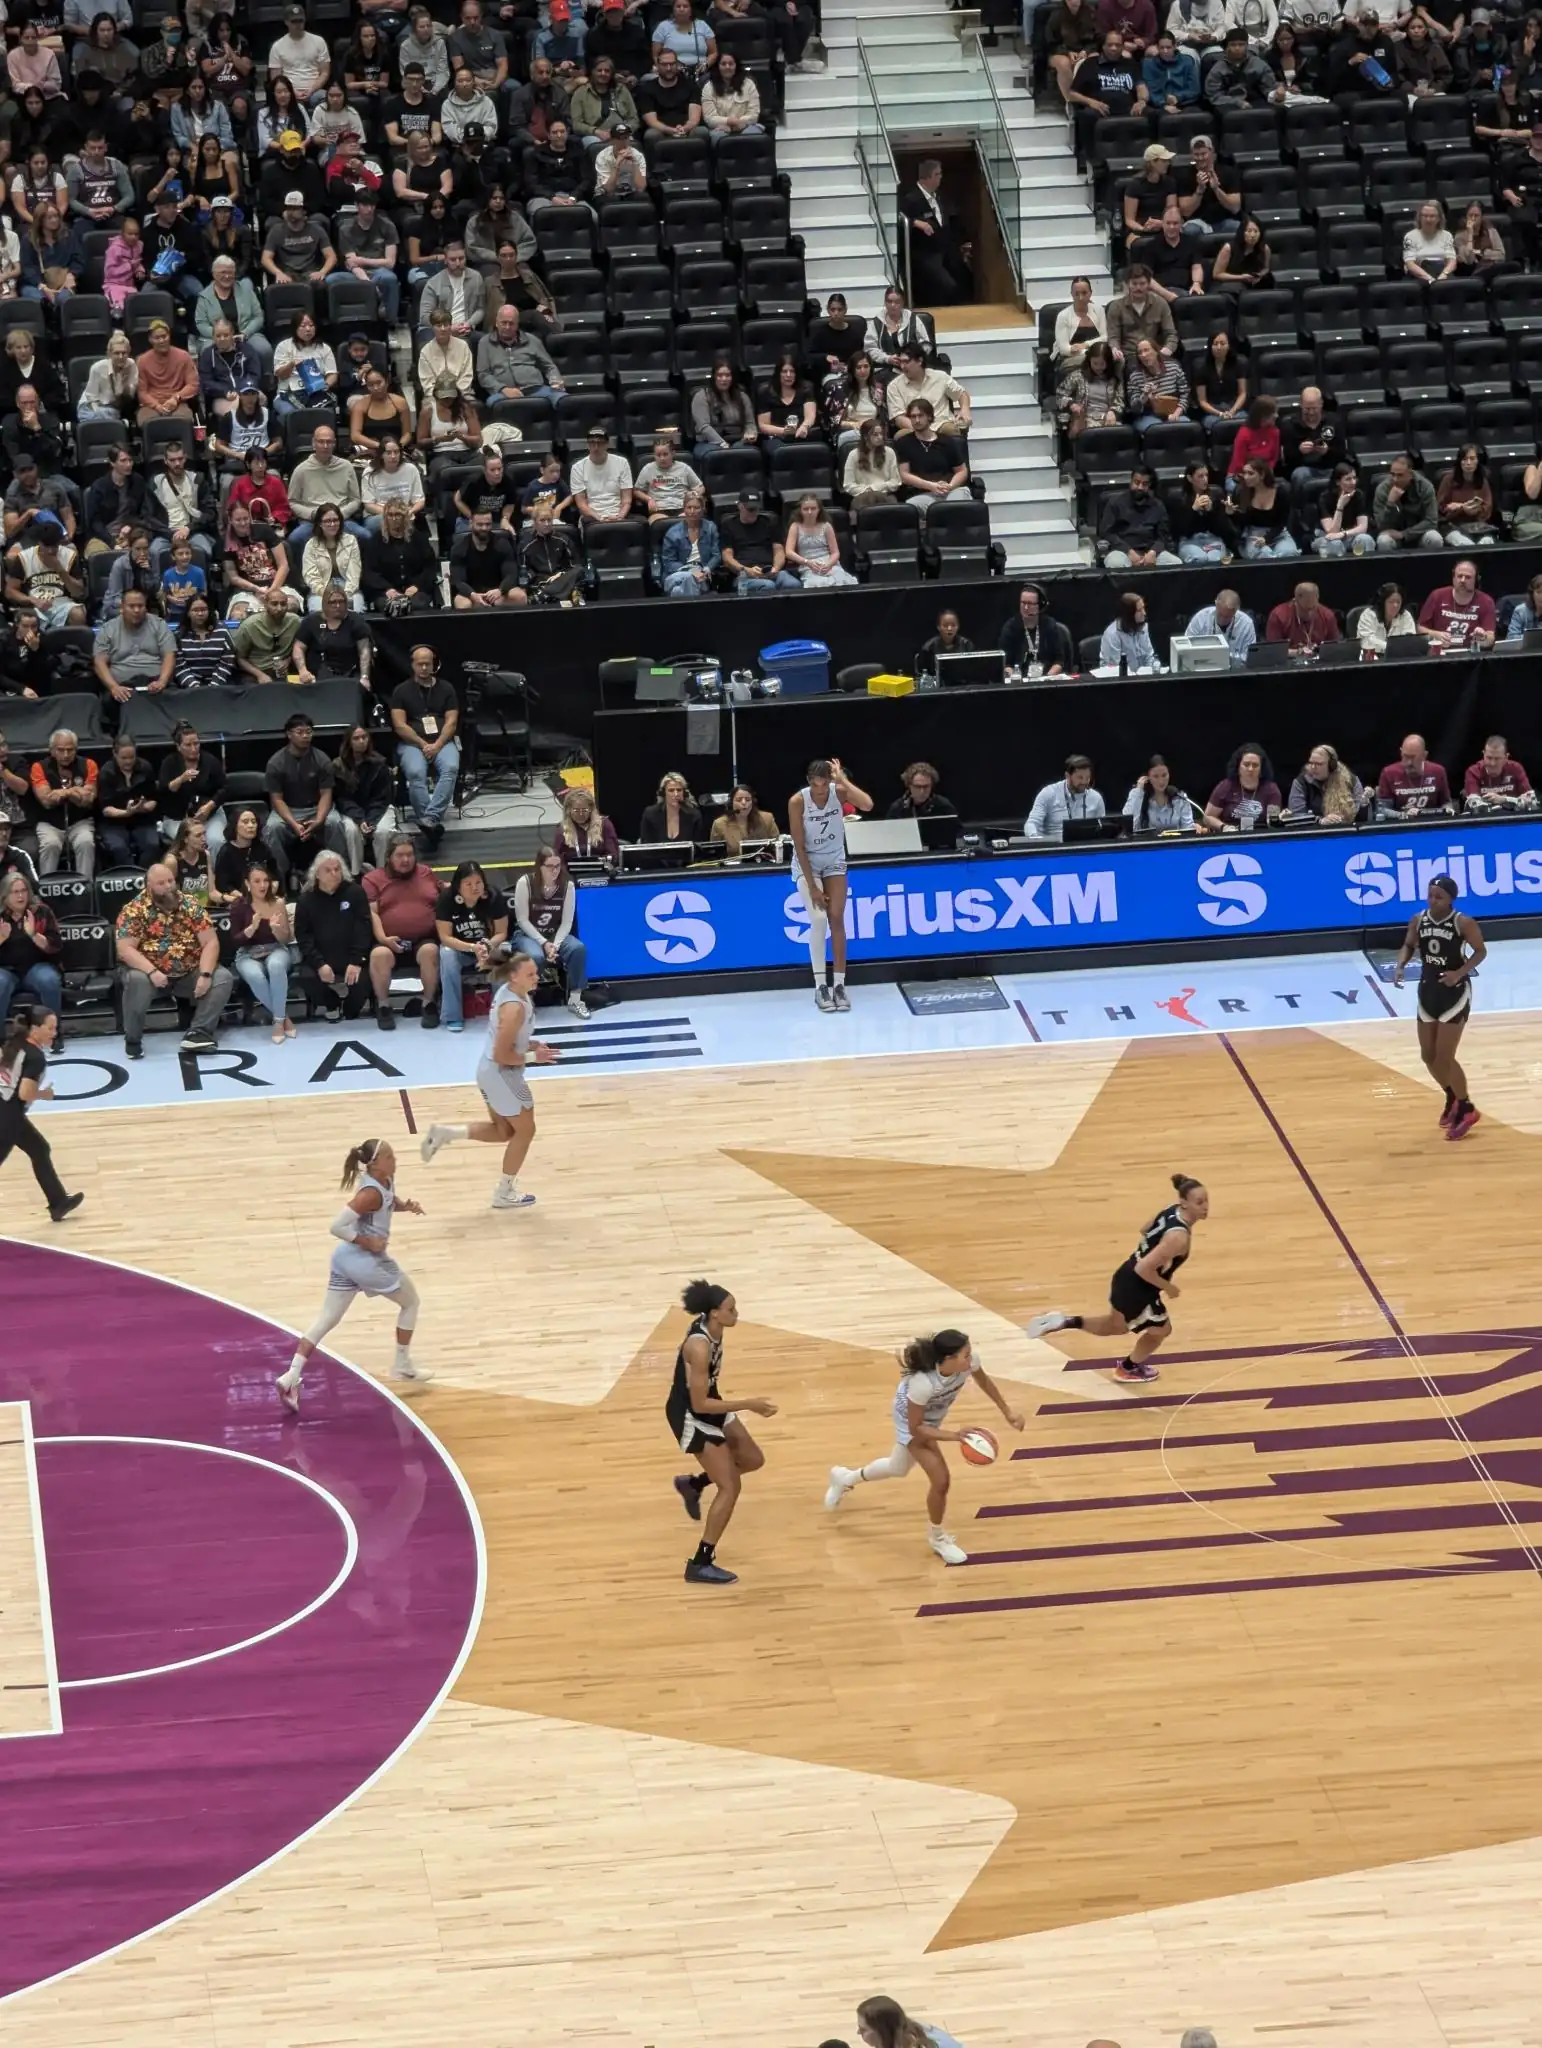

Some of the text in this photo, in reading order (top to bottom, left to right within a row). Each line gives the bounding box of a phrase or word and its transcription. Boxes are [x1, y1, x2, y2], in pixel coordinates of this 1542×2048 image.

[1097, 72, 1133, 90] TEMPO
[240, 435, 263, 448] 20
[1441, 609, 1479, 621] TORONTO
[1395, 785, 1436, 796] TORONTO
[1403, 795, 1429, 809] 20
[820, 821, 830, 834] 7
[38, 883, 72, 897] CIBC
[101, 878, 133, 893] CIBC
[536, 912, 553, 927] 3
[455, 921, 469, 933] LAS
[1420, 928, 1433, 938] LAS
[60, 927, 90, 941] CIBC
[1428, 939, 1441, 955] 0
[1425, 954, 1449, 967] IPSY
[912, 991, 997, 1004] TEMPO
